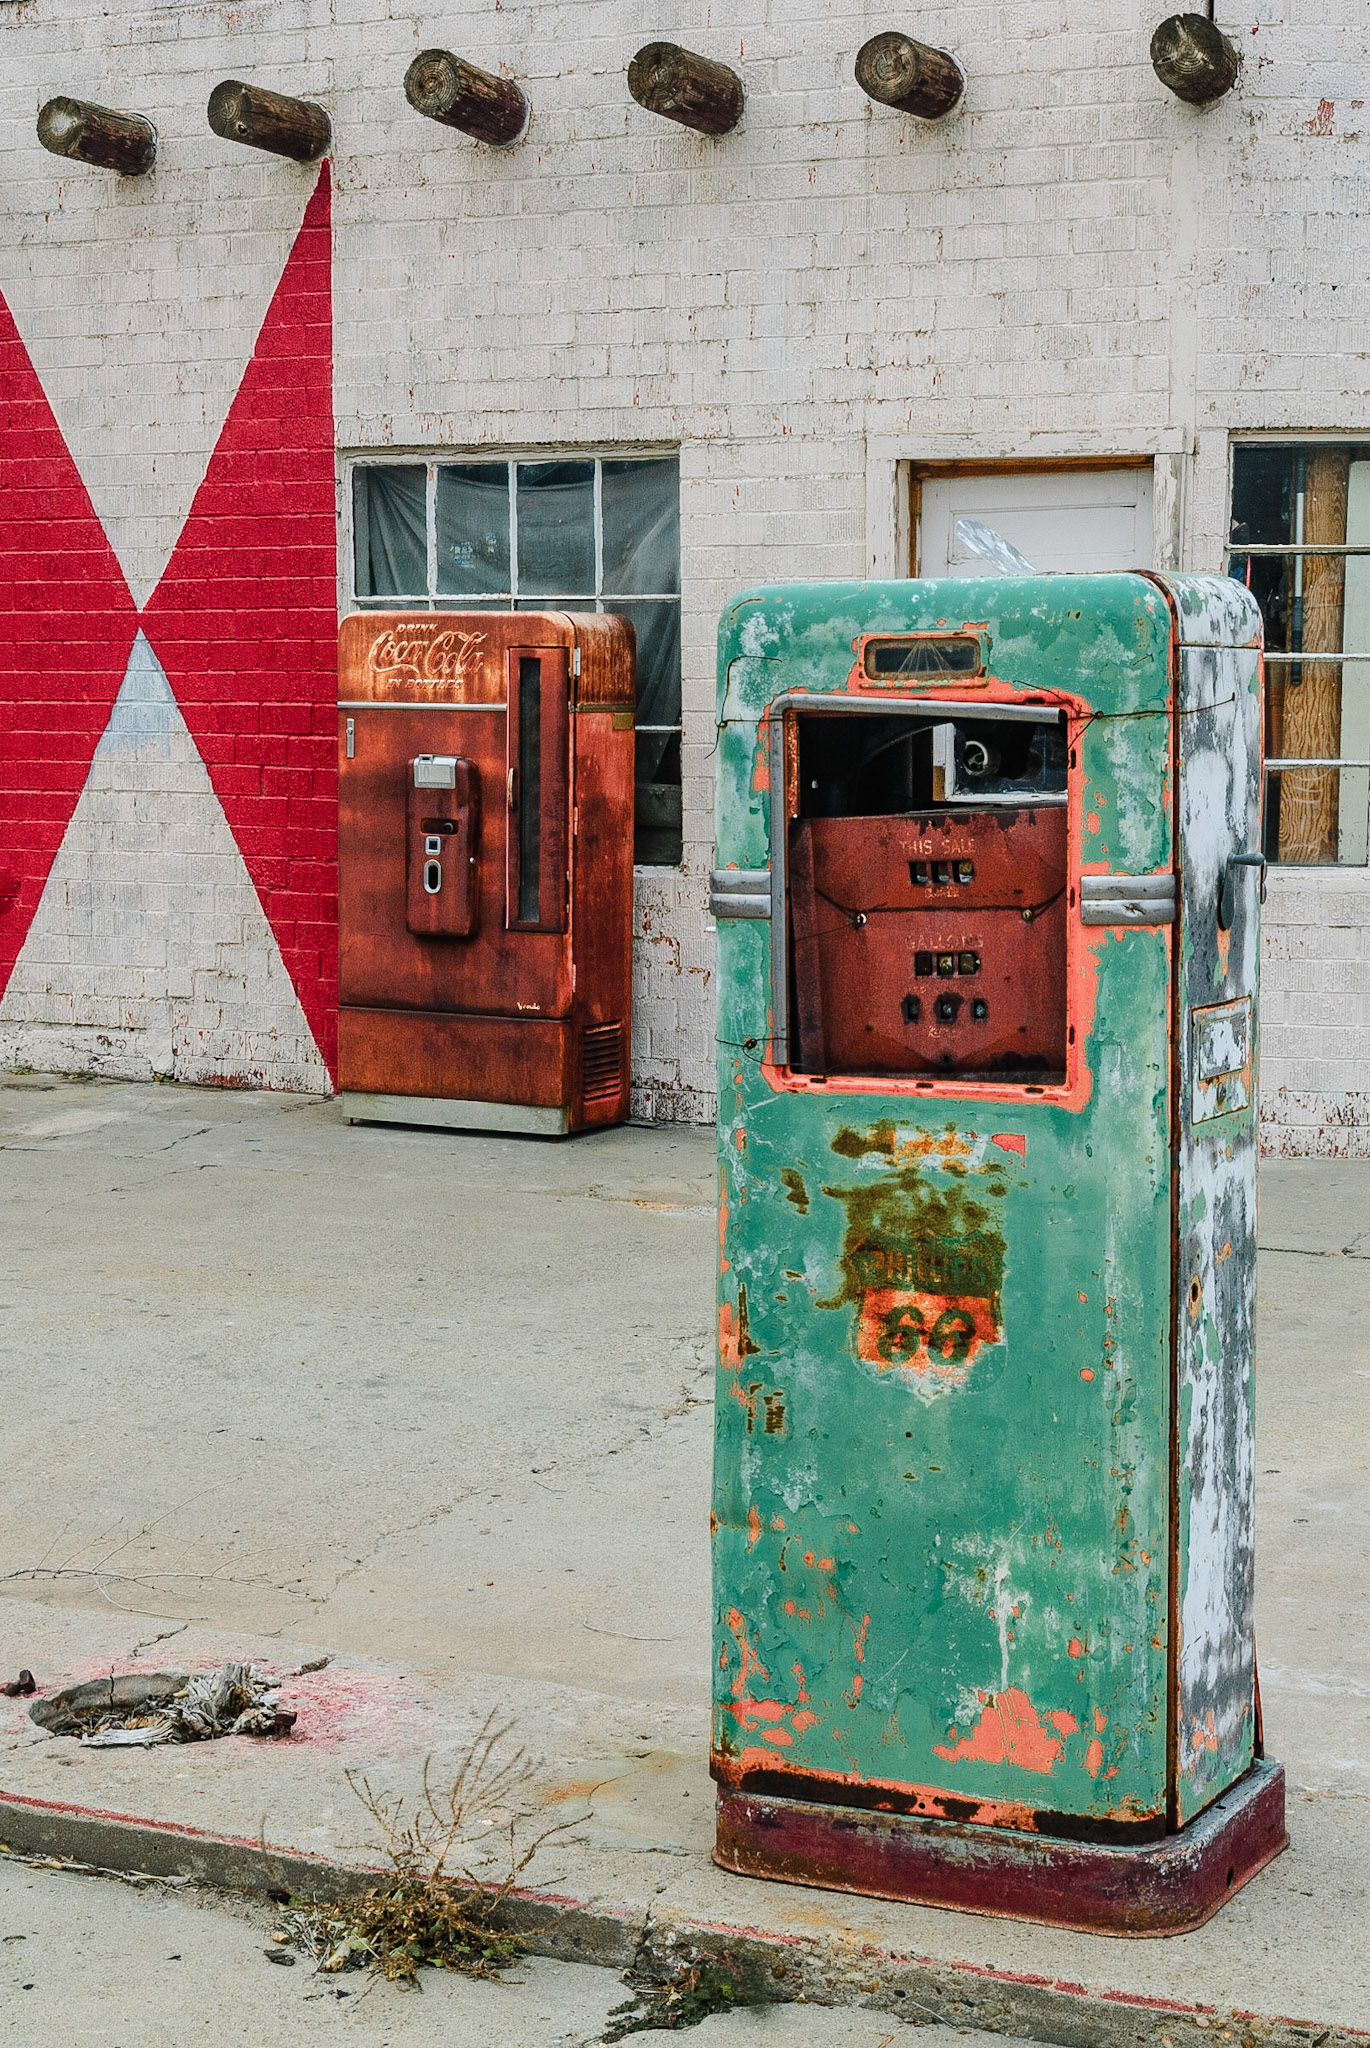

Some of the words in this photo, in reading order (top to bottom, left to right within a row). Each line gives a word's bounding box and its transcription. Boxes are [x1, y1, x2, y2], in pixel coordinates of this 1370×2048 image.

[395, 623, 438, 633] DRINK
[386, 678, 403, 689] IN
[404, 678, 465, 690] BOTTLES
[898, 839, 933, 855] THIS
[940, 838, 977, 854] SALE
[876, 1304, 977, 1366] 66
